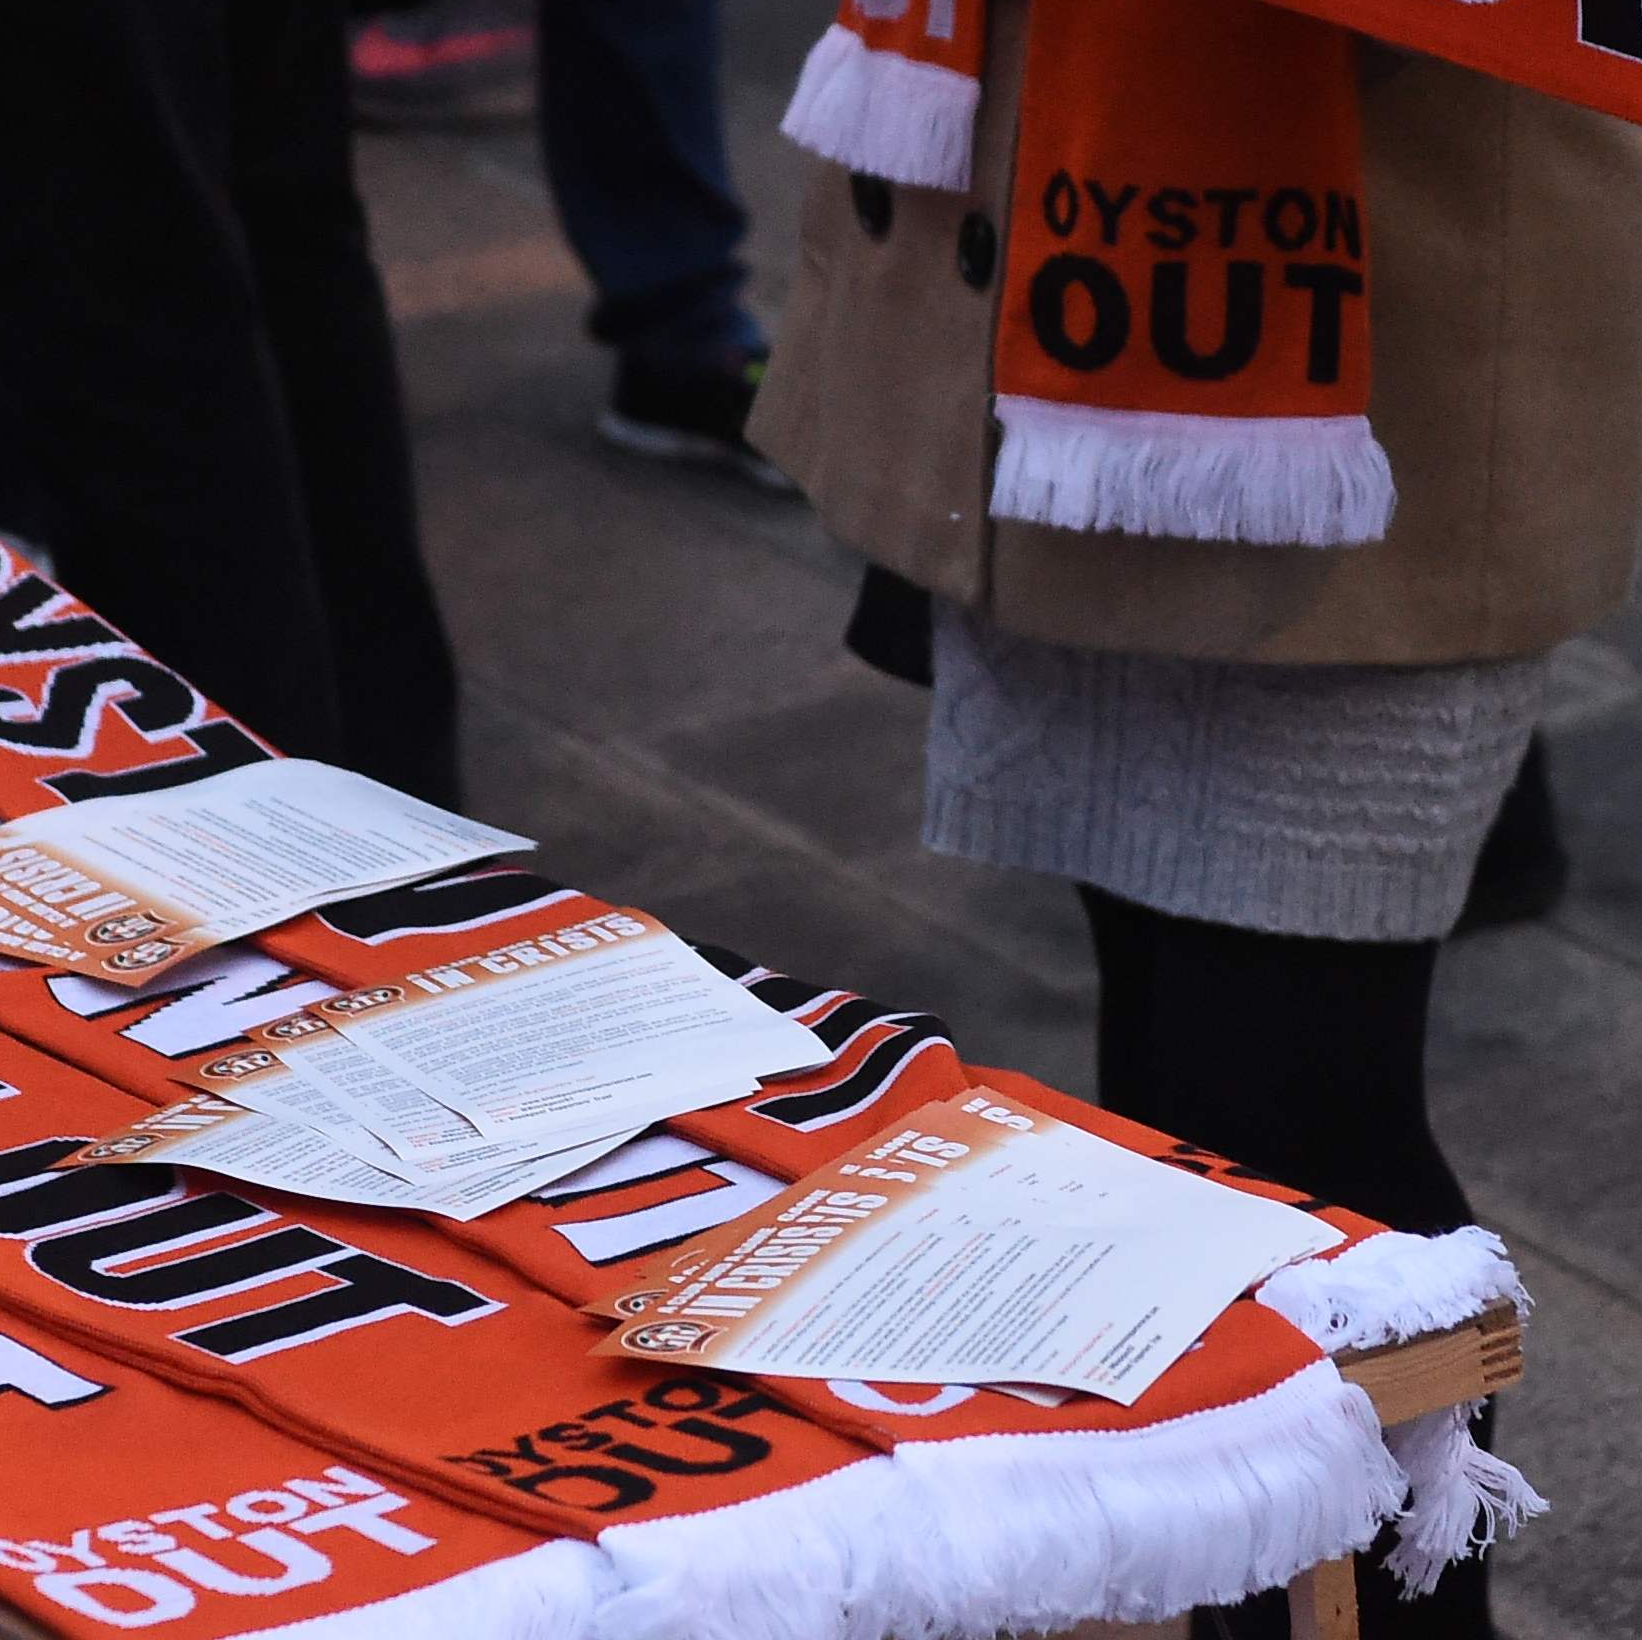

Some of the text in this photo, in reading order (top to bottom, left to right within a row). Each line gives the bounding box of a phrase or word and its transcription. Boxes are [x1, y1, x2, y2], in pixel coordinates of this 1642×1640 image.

[1043, 168, 1361, 260] OYSTON
[1029, 251, 1363, 385] OUT
[407, 913, 648, 994] IN CRISIS
[34, 1492, 438, 1629] OUT
